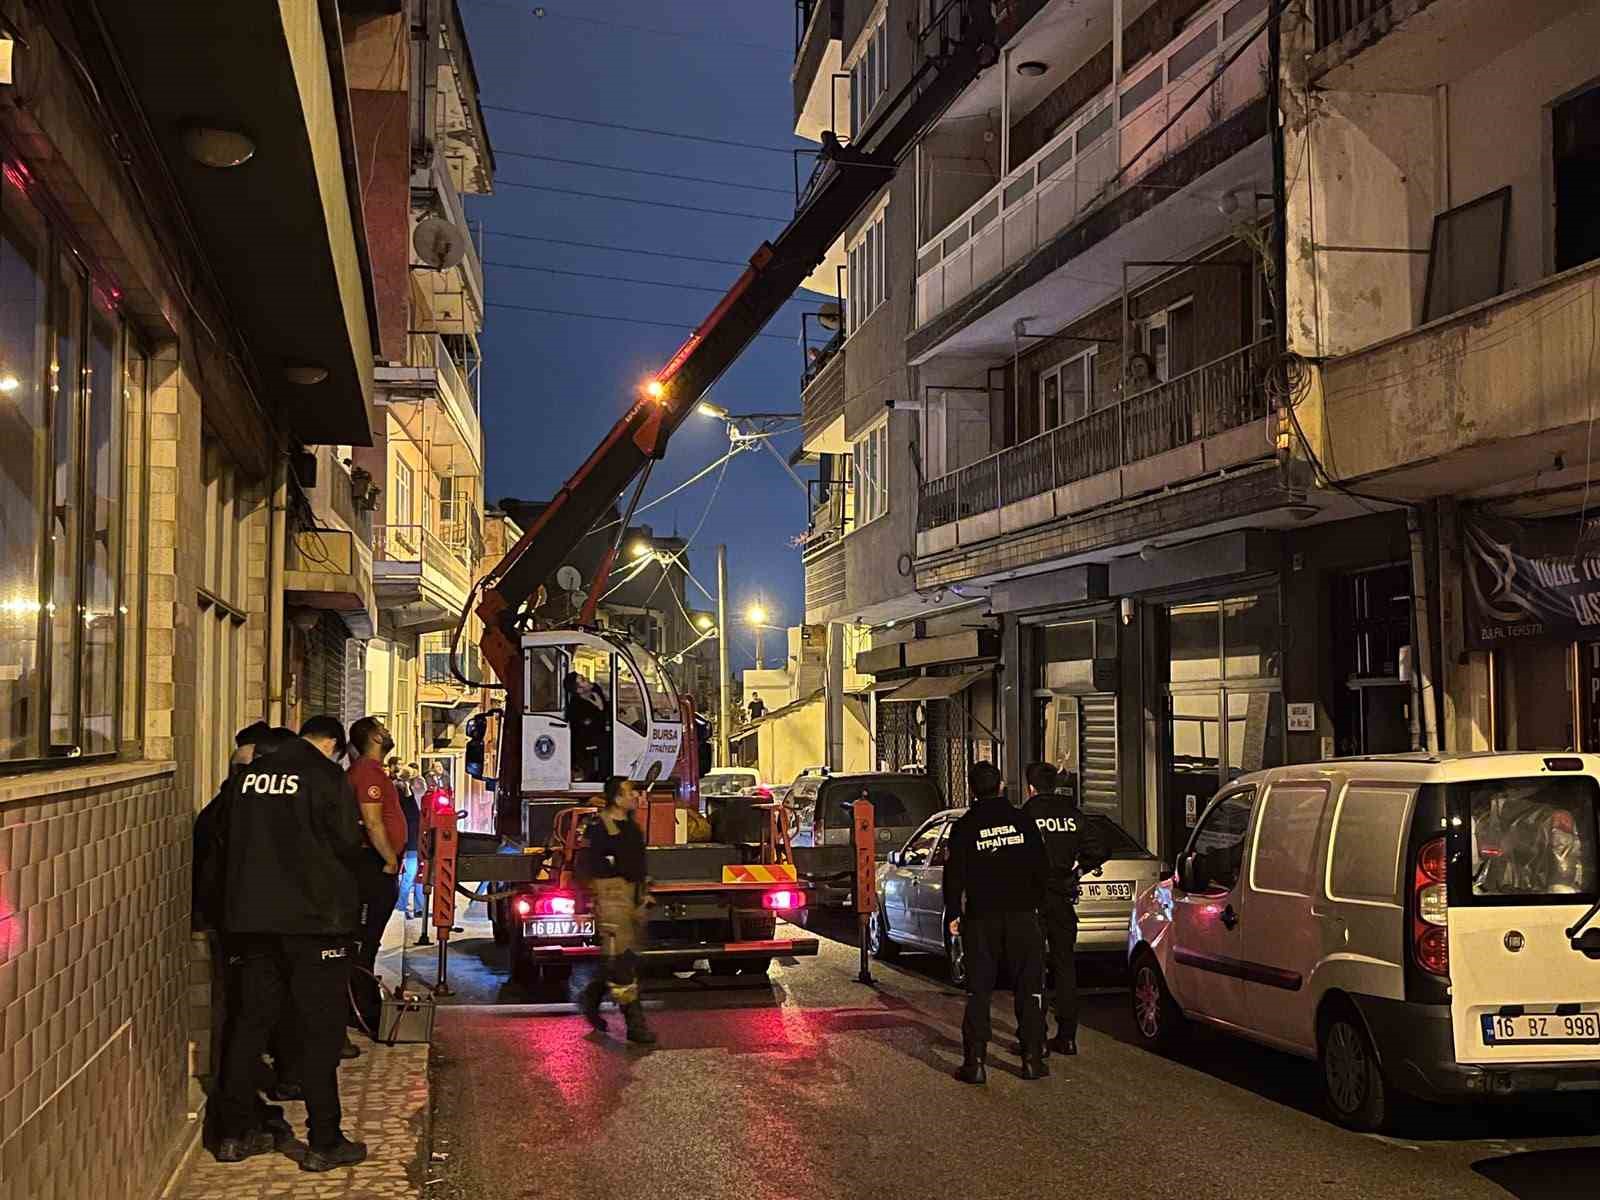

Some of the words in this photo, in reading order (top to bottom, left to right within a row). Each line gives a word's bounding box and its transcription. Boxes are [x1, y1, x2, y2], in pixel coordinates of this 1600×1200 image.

[652, 728, 678, 740] BURSA
[979, 825, 1017, 838] BURSA
[1088, 885, 1101, 896] HC
[1106, 885, 1130, 896] 9693
[531, 922, 544, 935] 16
[1496, 1018, 1514, 1037] 16
[1528, 1018, 1549, 1036] BZ
[1564, 1017, 1595, 1036] 998
